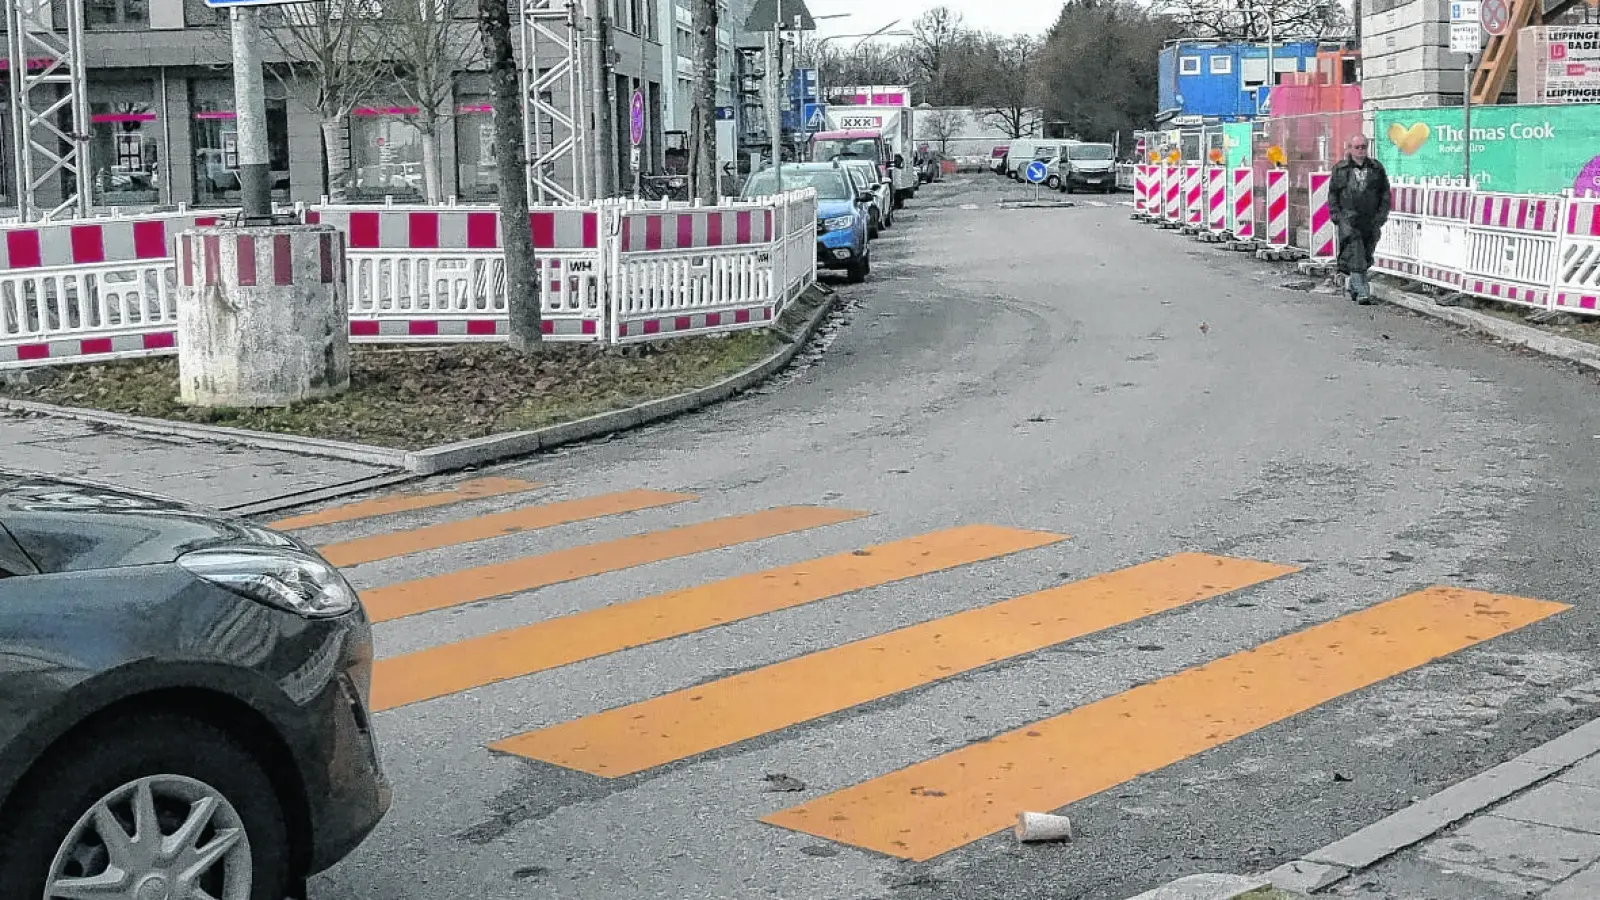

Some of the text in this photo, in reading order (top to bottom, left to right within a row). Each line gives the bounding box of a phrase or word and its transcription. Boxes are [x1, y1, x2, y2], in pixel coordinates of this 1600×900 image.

[1568, 41, 1600, 50] BADE
[1434, 121, 1555, 142] Thomas Cook
[569, 260, 592, 272] WH
